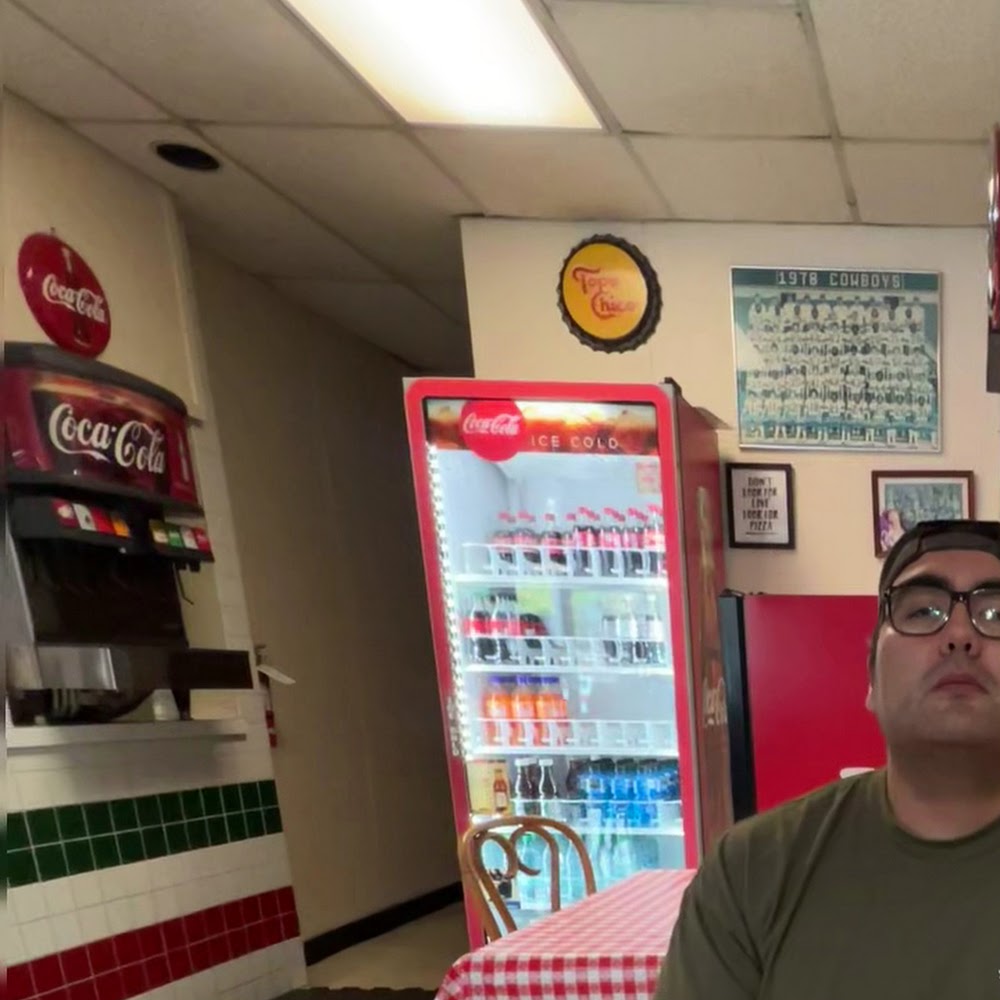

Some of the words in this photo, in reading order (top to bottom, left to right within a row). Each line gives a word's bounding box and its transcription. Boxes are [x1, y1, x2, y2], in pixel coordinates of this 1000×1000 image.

[778, 271, 819, 286] 1978
[829, 272, 901, 289] COWBOYS
[43, 274, 106, 323] Coca-Cola
[462, 411, 522, 436] Coca-Cola
[49, 403, 164, 474] Coca-Cola
[530, 434, 560, 448] ICE
[570, 435, 619, 450] COLD
